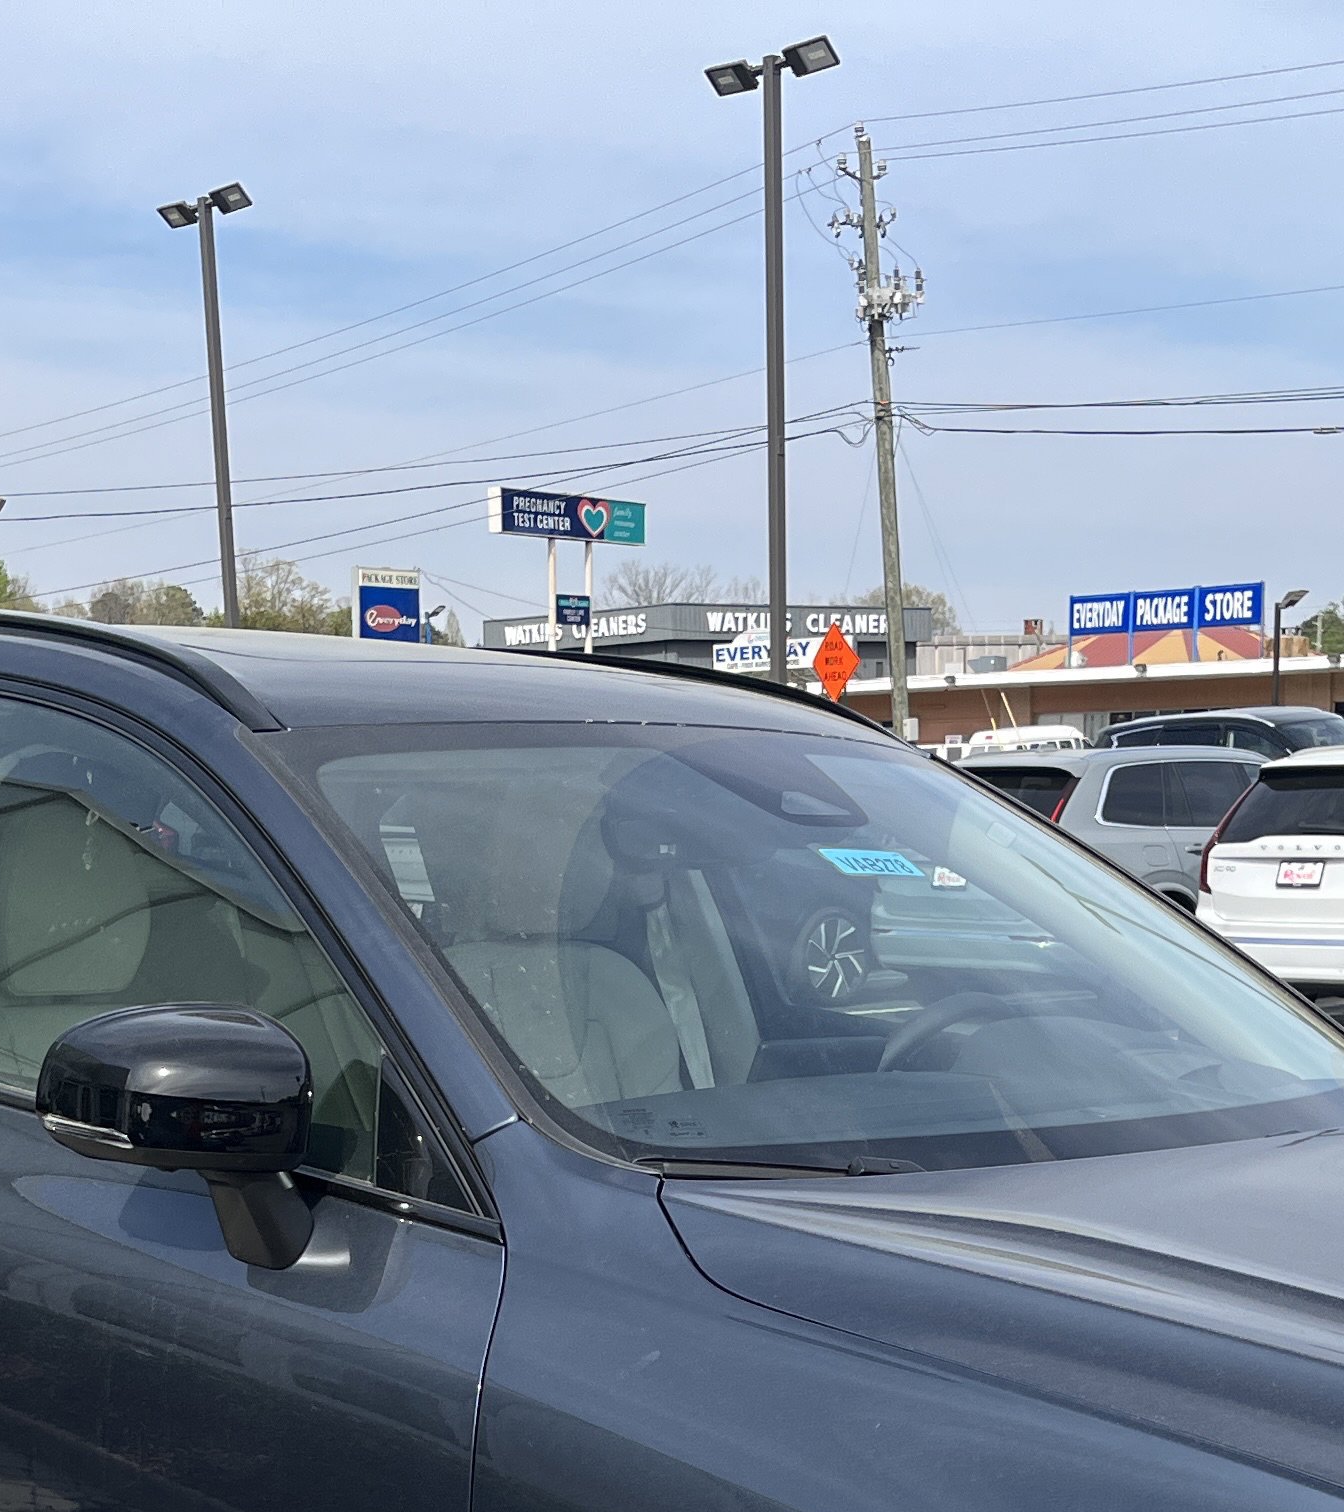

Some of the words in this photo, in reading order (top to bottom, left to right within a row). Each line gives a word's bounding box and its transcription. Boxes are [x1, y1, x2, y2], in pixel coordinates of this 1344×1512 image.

[512, 496, 566, 515] PREGNANCY
[512, 512, 535, 527] TEST
[536, 514, 571, 531] CENTER
[1072, 600, 1125, 629] EVERYDAY
[1136, 596, 1188, 625] PACKAGE
[1204, 590, 1253, 621] STORE
[806, 613, 888, 634] CLEANER
[715, 641, 810, 664] EVERYAY
[1260, 844, 1342, 852] VOLVO
[836, 856, 915, 874] VAB278
